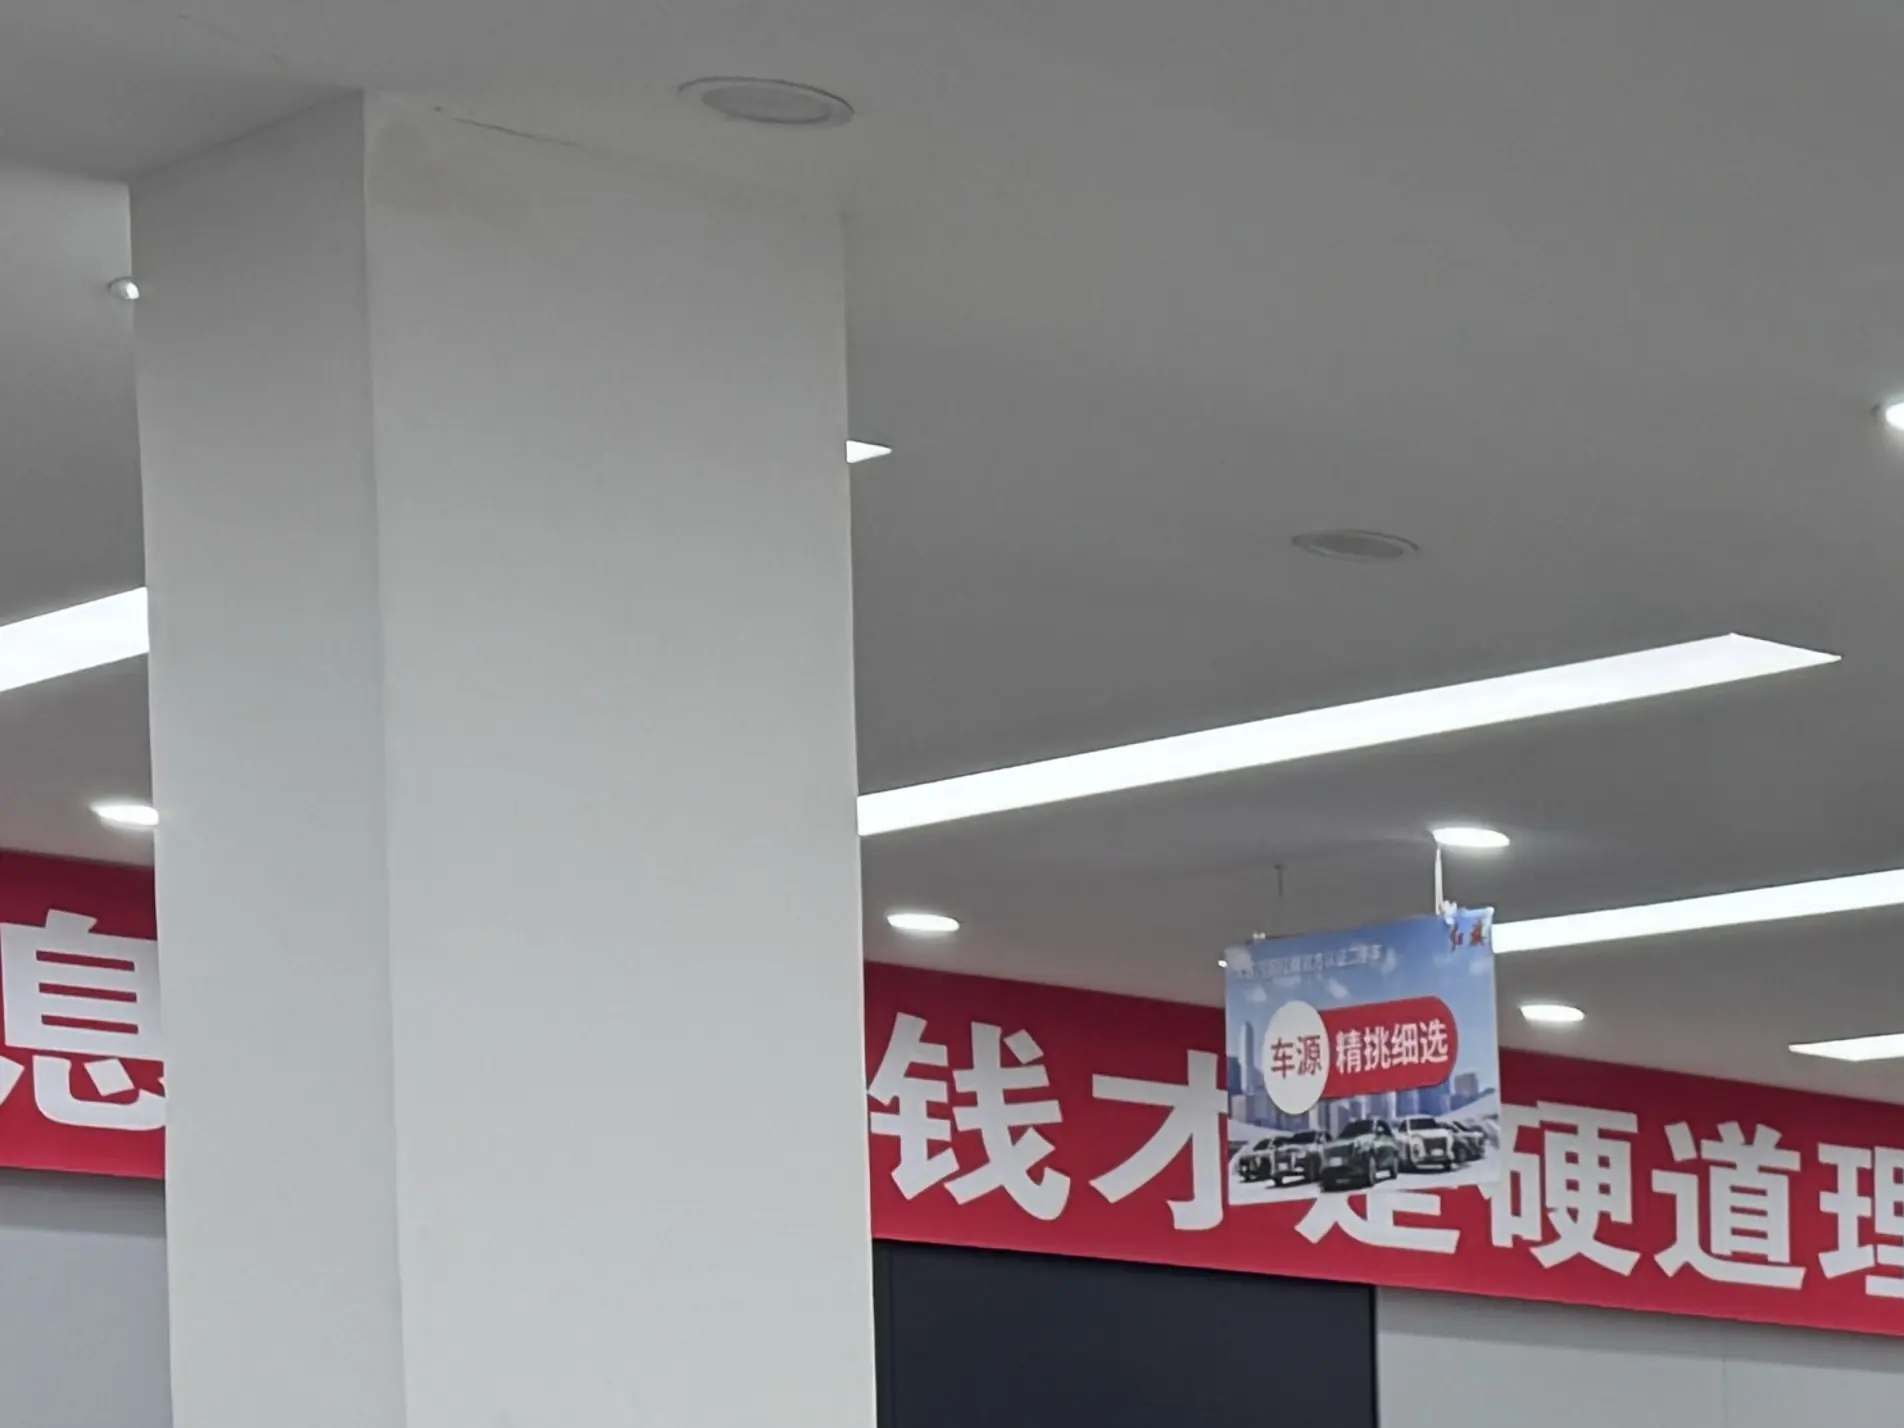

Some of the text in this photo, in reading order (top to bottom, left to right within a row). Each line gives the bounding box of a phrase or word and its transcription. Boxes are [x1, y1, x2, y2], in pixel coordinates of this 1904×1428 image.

[0, 908, 166, 1131] 息
[1270, 1018, 1449, 1079] 车源 精挑细选
